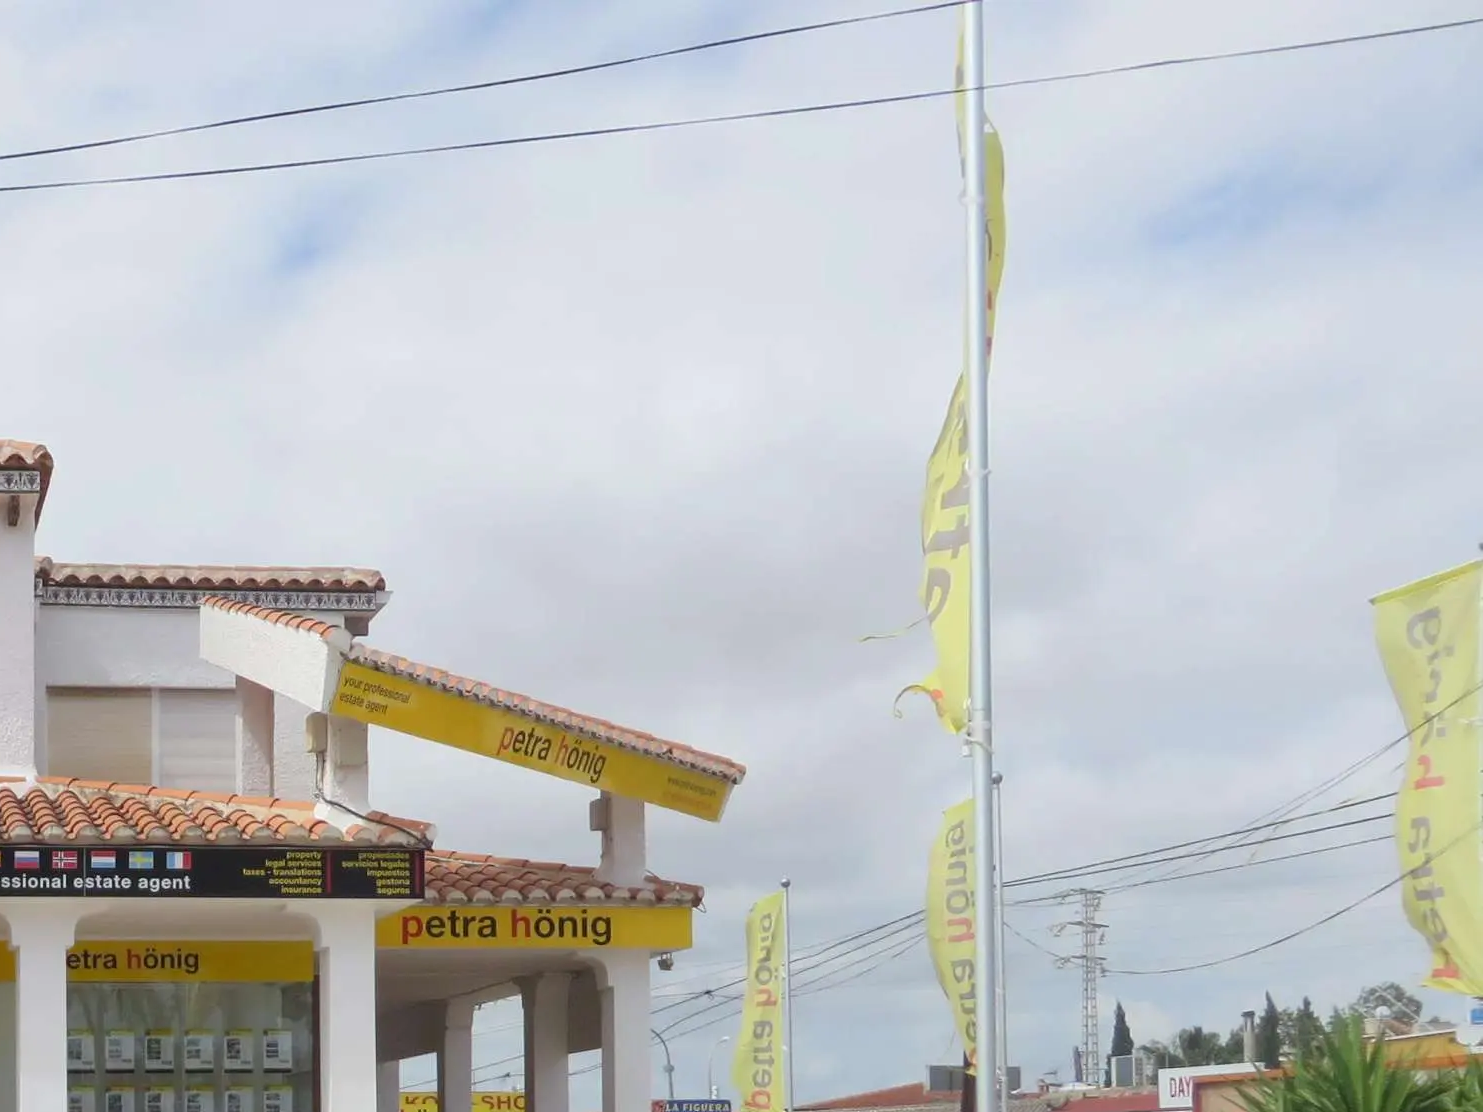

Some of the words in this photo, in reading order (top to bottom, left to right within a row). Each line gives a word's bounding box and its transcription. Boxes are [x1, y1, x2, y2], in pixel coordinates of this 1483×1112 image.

[343, 675, 365, 689] your
[363, 682, 412, 704] professional
[339, 692, 365, 708] estate
[364, 700, 389, 715] agent
[496, 724, 550, 761] petra
[558, 729, 608, 784] hönig
[73, 876, 132, 890] estate
[137, 876, 191, 892] agent
[402, 909, 497, 945] petra
[510, 908, 613, 946] hönig
[126, 947, 200, 974] hönig
[665, 1103, 680, 1112] LA
[682, 1103, 730, 1112] FIGUERA
